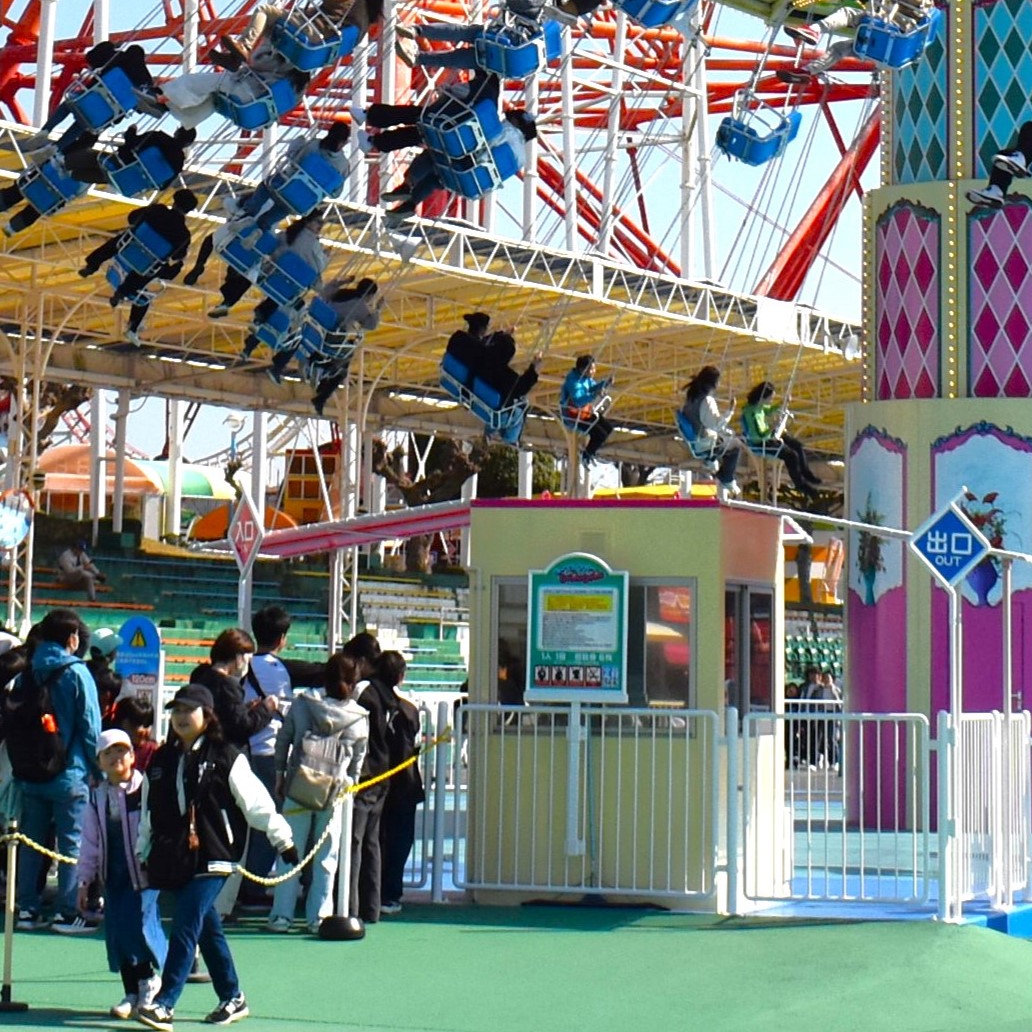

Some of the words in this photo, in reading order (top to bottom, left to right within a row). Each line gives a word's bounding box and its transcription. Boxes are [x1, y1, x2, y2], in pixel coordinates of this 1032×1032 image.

[235, 521, 254, 543] 入口
[926, 530, 972, 555] 出口
[935, 555, 962, 567] OUT
